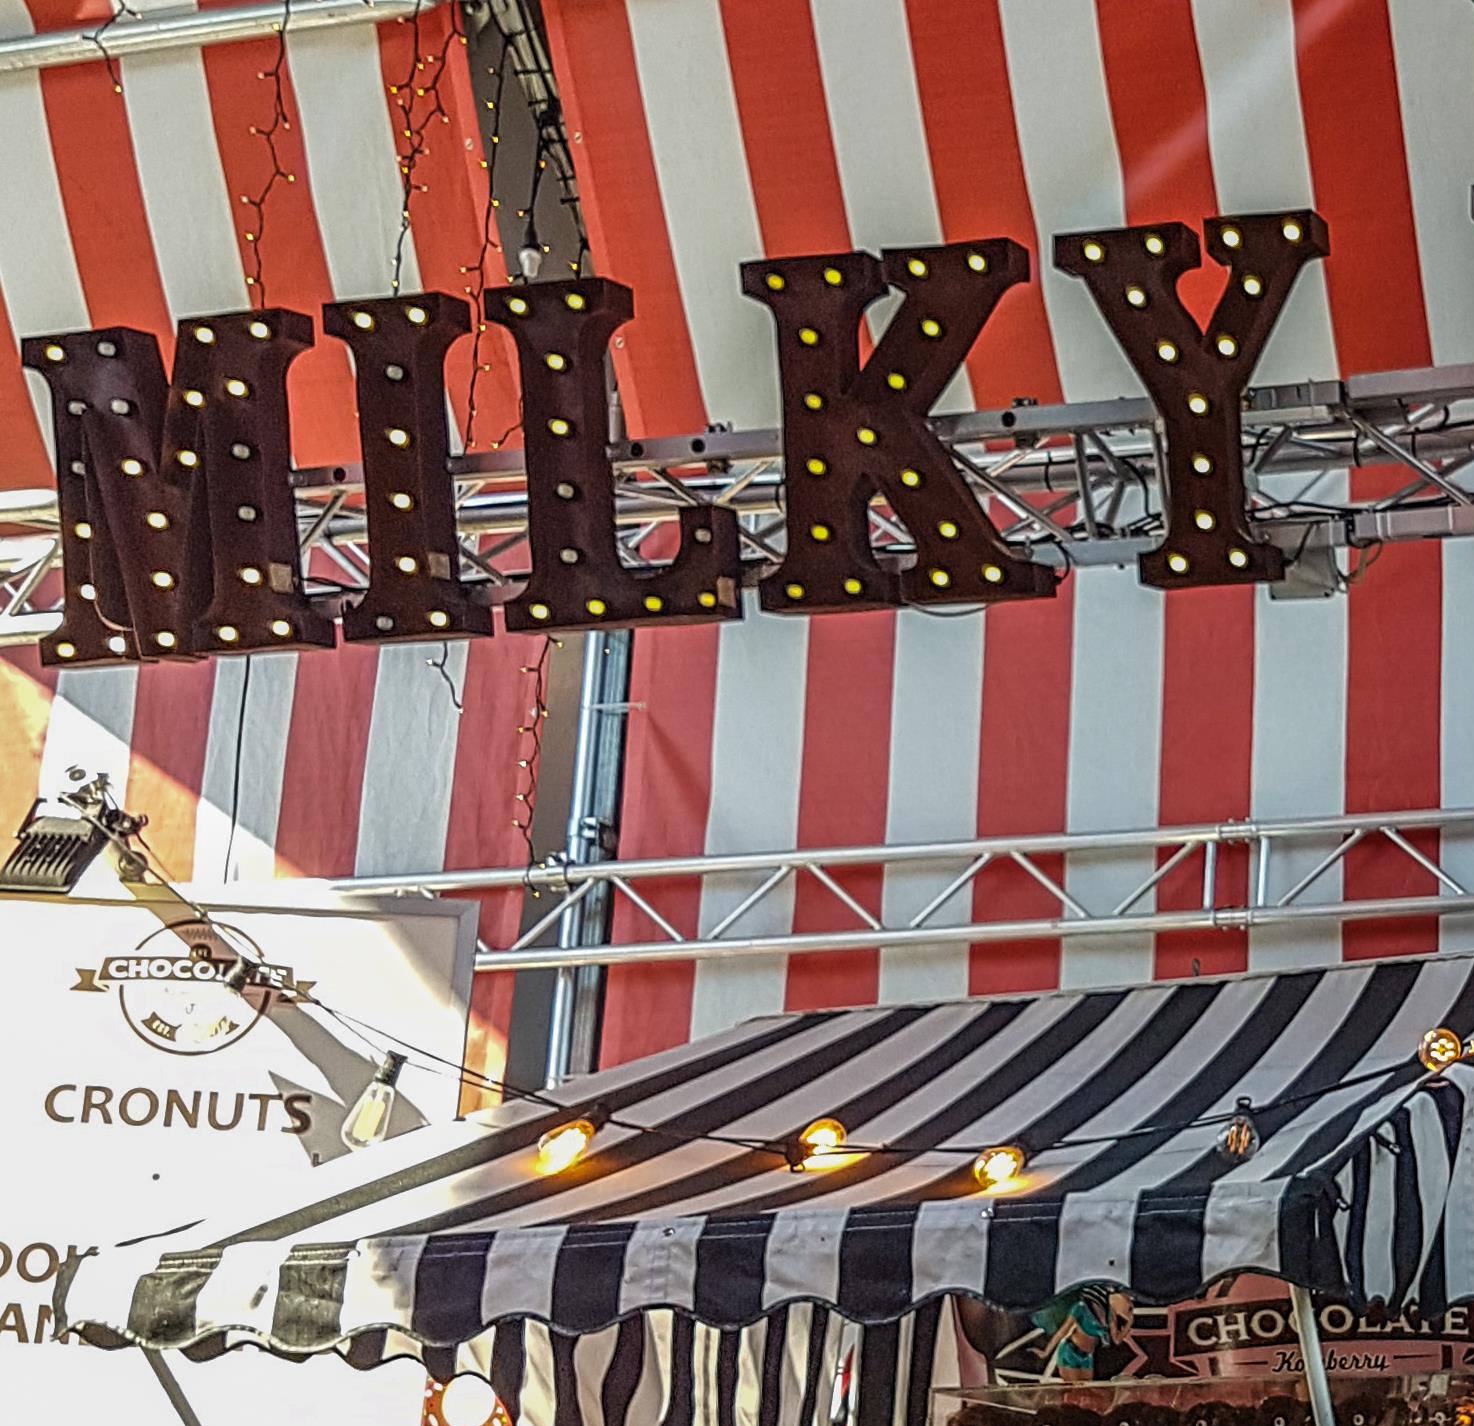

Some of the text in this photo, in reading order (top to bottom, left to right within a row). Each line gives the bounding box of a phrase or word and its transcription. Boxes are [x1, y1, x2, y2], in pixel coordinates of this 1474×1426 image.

[22, 211, 1329, 667] MILKY
[44, 1084, 312, 1135] CRONUTS
[1272, 1351, 1390, 1373] Koberry
